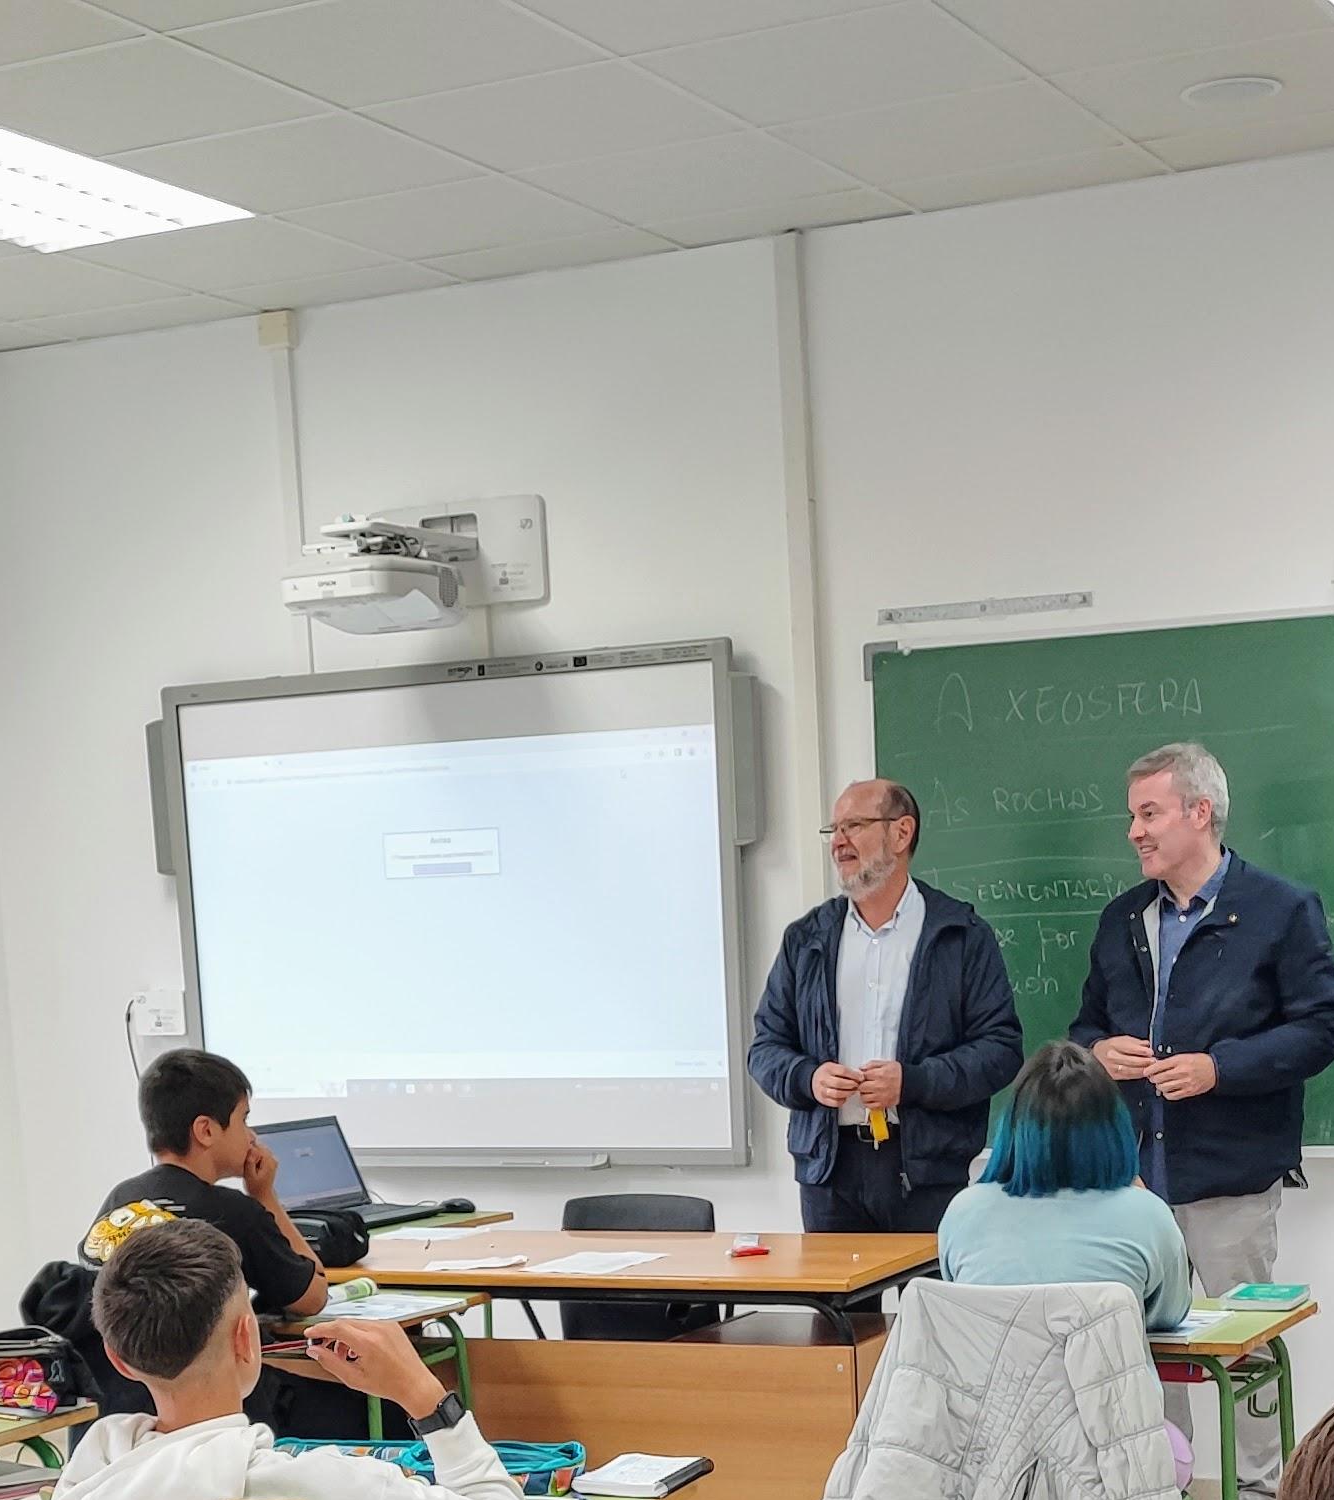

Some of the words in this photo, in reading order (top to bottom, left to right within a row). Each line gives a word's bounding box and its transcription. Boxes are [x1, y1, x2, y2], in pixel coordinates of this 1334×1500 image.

[934, 672, 974, 735] A
[1004, 677, 1204, 726] XEOSFERA
[992, 783, 1104, 815] ROCHAS
